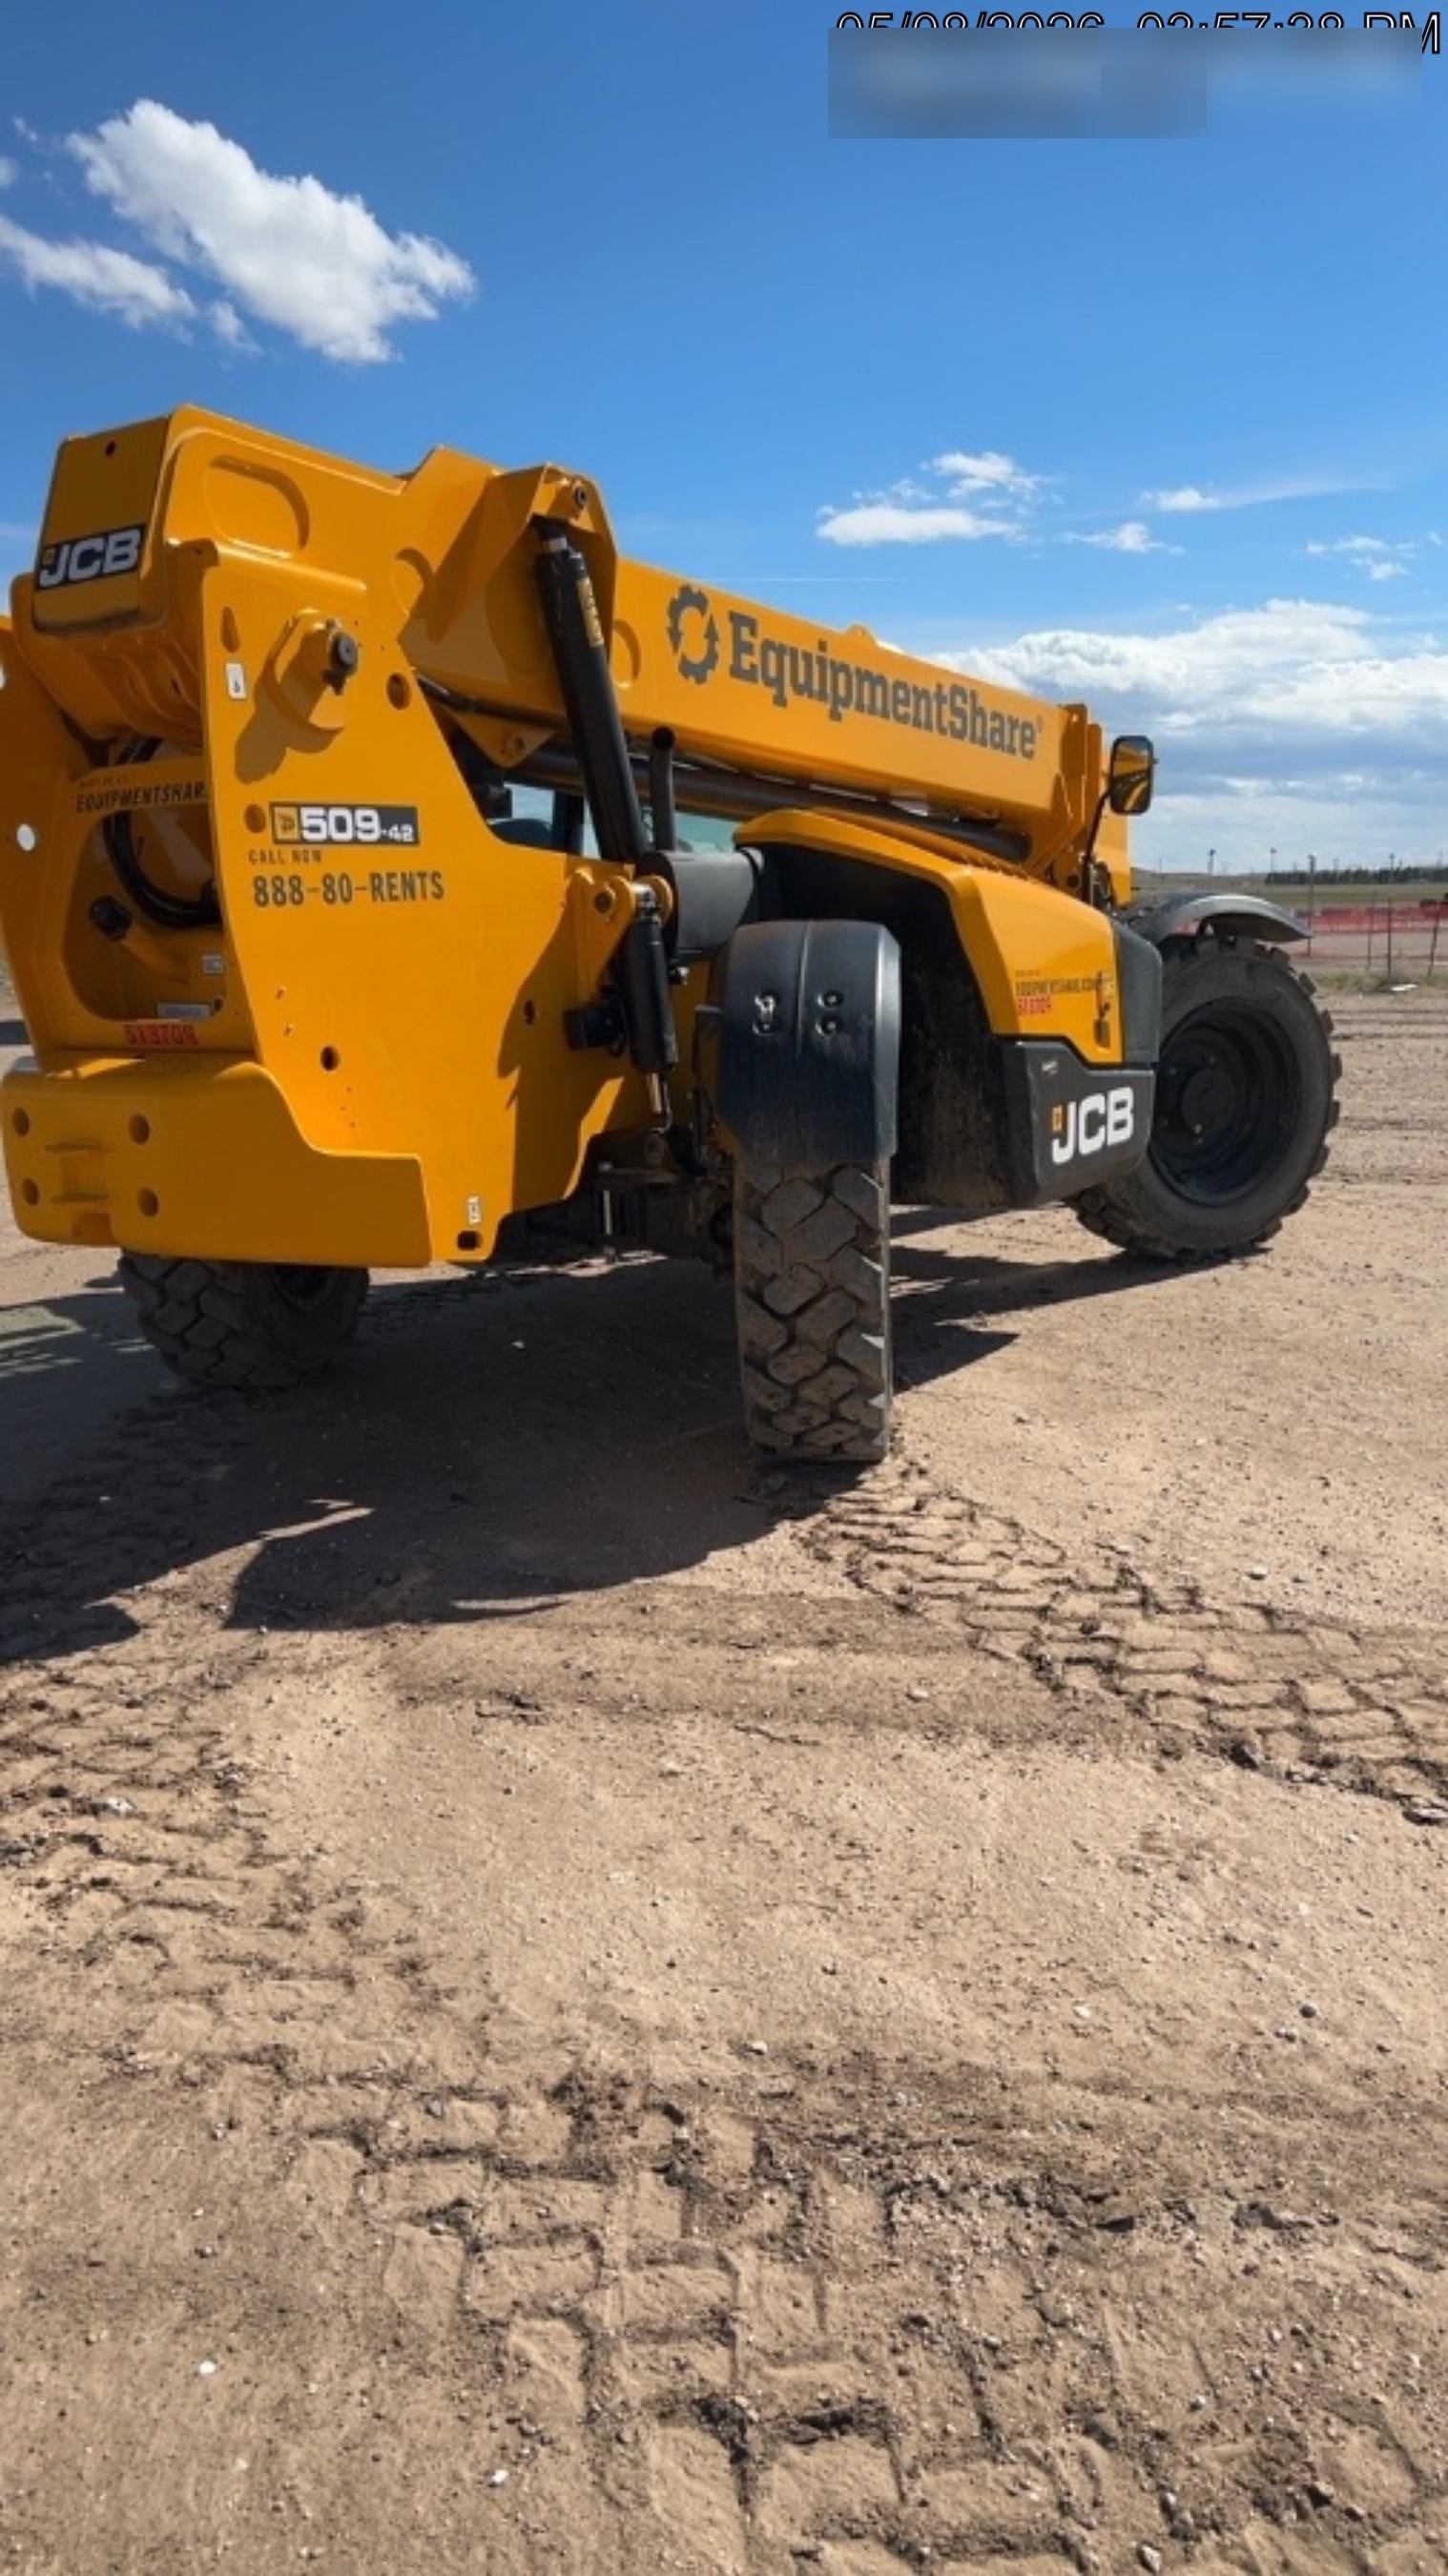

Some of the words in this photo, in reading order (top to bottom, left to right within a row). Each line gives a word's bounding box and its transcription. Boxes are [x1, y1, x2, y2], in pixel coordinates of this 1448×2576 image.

[38, 528, 141, 588] JCB
[729, 609, 1037, 759] EquipmentShare
[300, 807, 415, 842] 509-42
[248, 850, 285, 864] CALL
[292, 848, 321, 863] NOW
[253, 870, 445, 907] 888-80-RENTS
[1052, 1086, 1135, 1164] JCB
